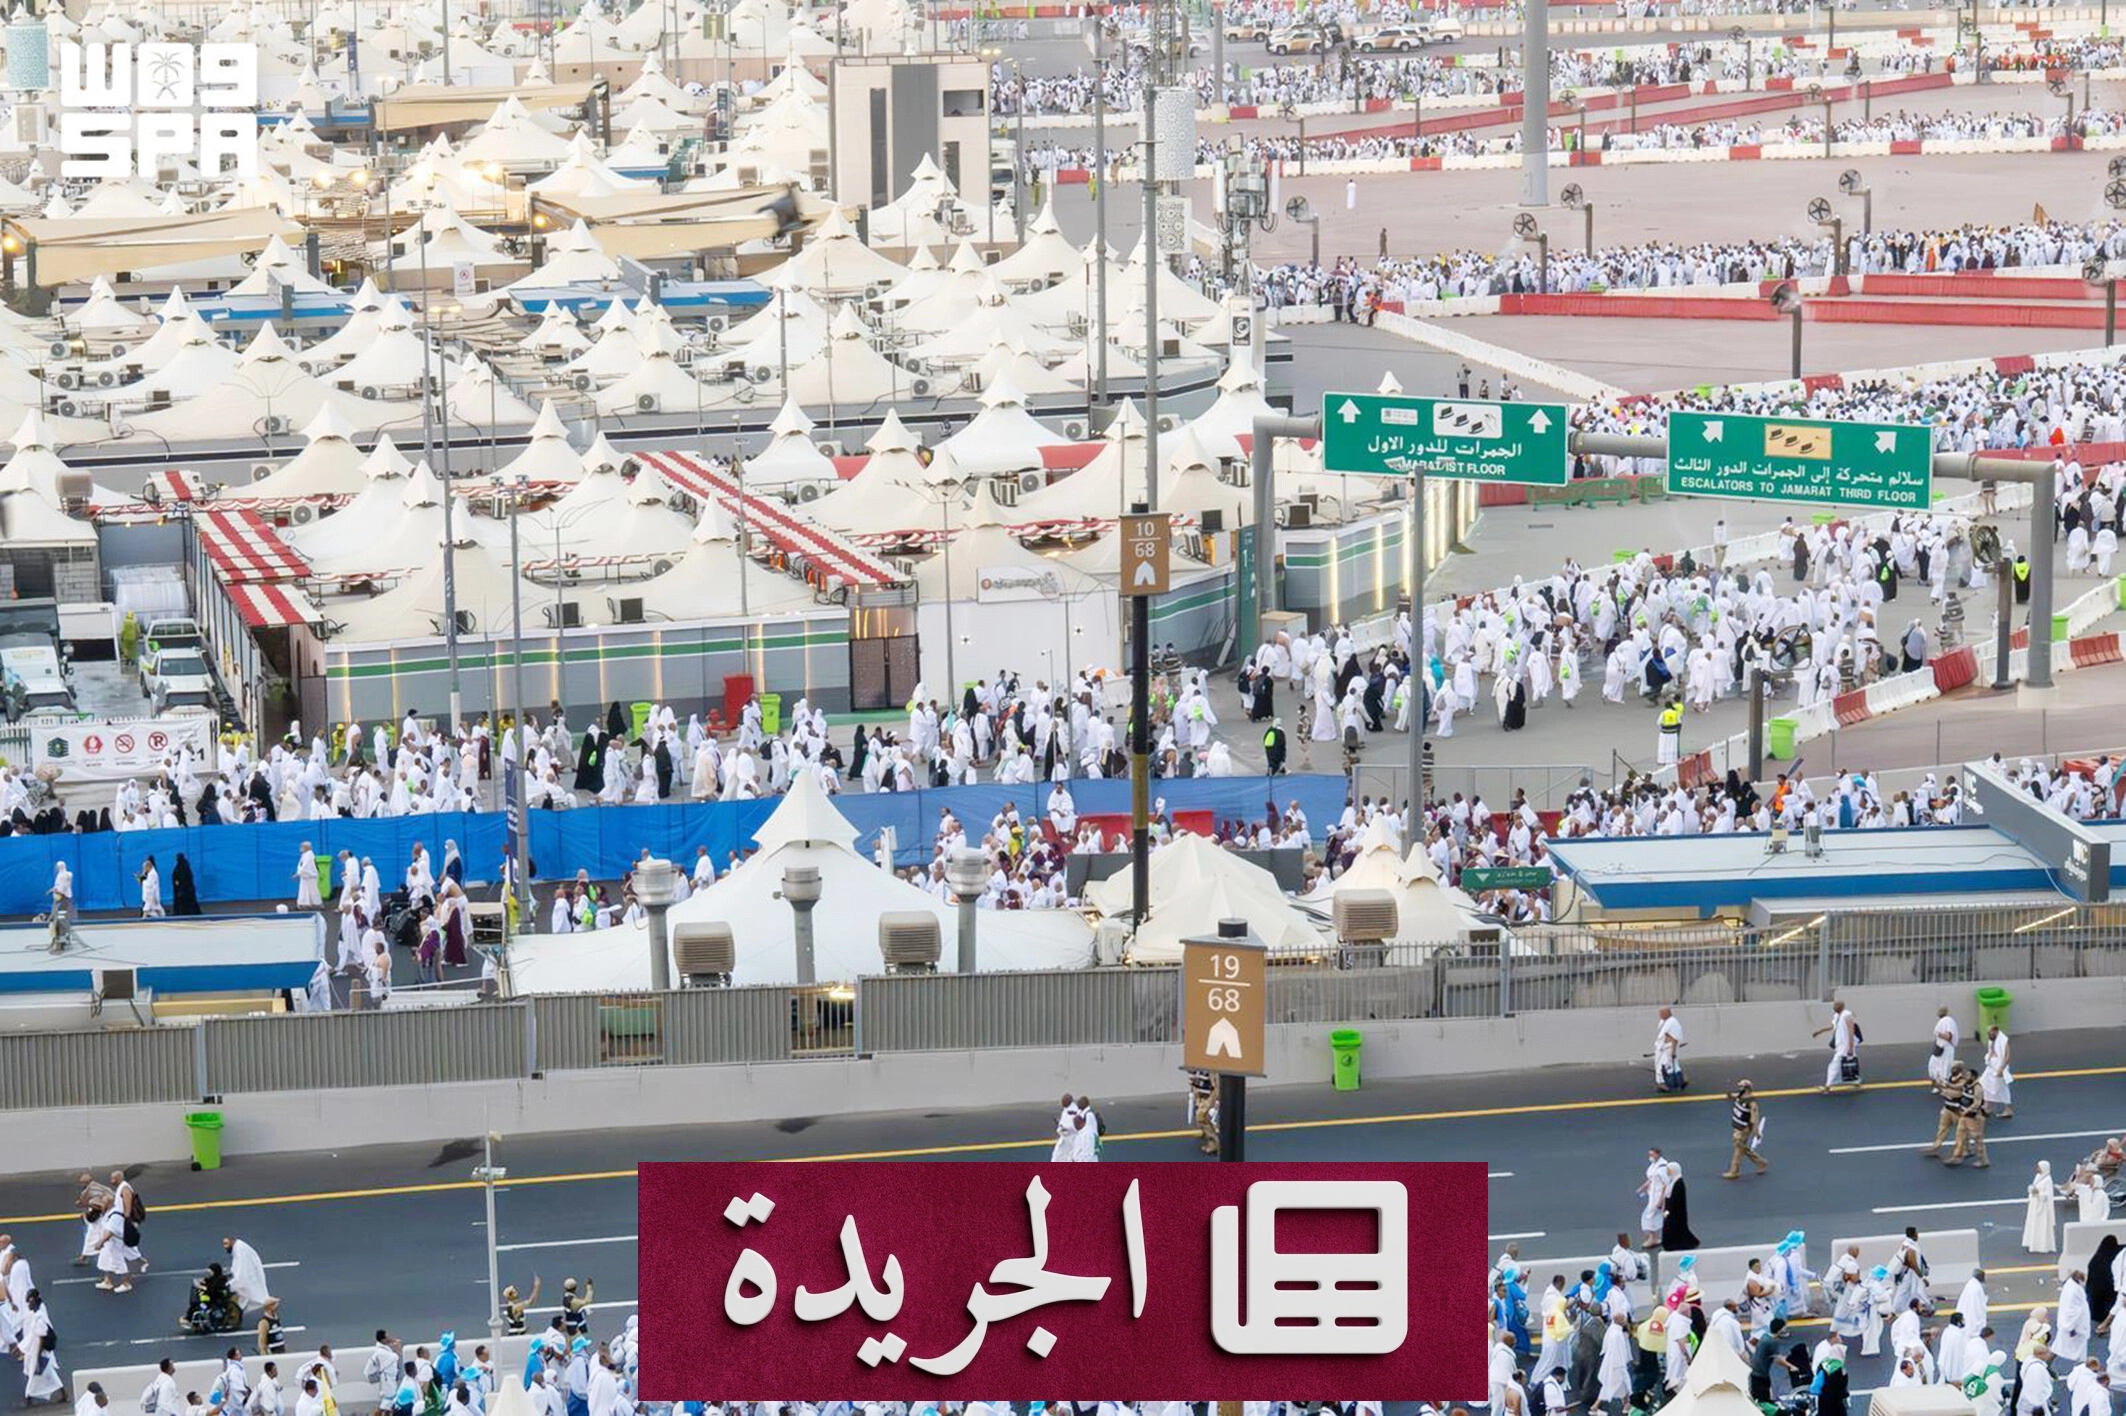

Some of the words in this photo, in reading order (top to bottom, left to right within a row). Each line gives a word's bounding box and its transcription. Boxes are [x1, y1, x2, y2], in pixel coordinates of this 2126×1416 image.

[1407, 438, 1448, 455] للدور
[1455, 440, 1522, 459] الجمرات
[1467, 463, 1506, 475] FLOOR
[1674, 457, 1711, 472] الثالث
[1715, 461, 1747, 477] الدور
[1752, 462, 1805, 480] الجمرات
[1810, 466, 1830, 485] إلى
[1836, 467, 1883, 485] متحركة
[1888, 470, 1924, 487] سلالم
[1681, 477, 1753, 492] ESCALATORS
[1760, 482, 1774, 493] TO
[1780, 484, 1832, 497] JAMARAT
[1839, 487, 1872, 499] THIRD
[1878, 490, 1917, 503] FLOOR
[1136, 521, 1155, 537] 10
[1135, 542, 1156, 557] 68
[1210, 954, 1240, 979] 19
[1208, 987, 1240, 1012] 68
